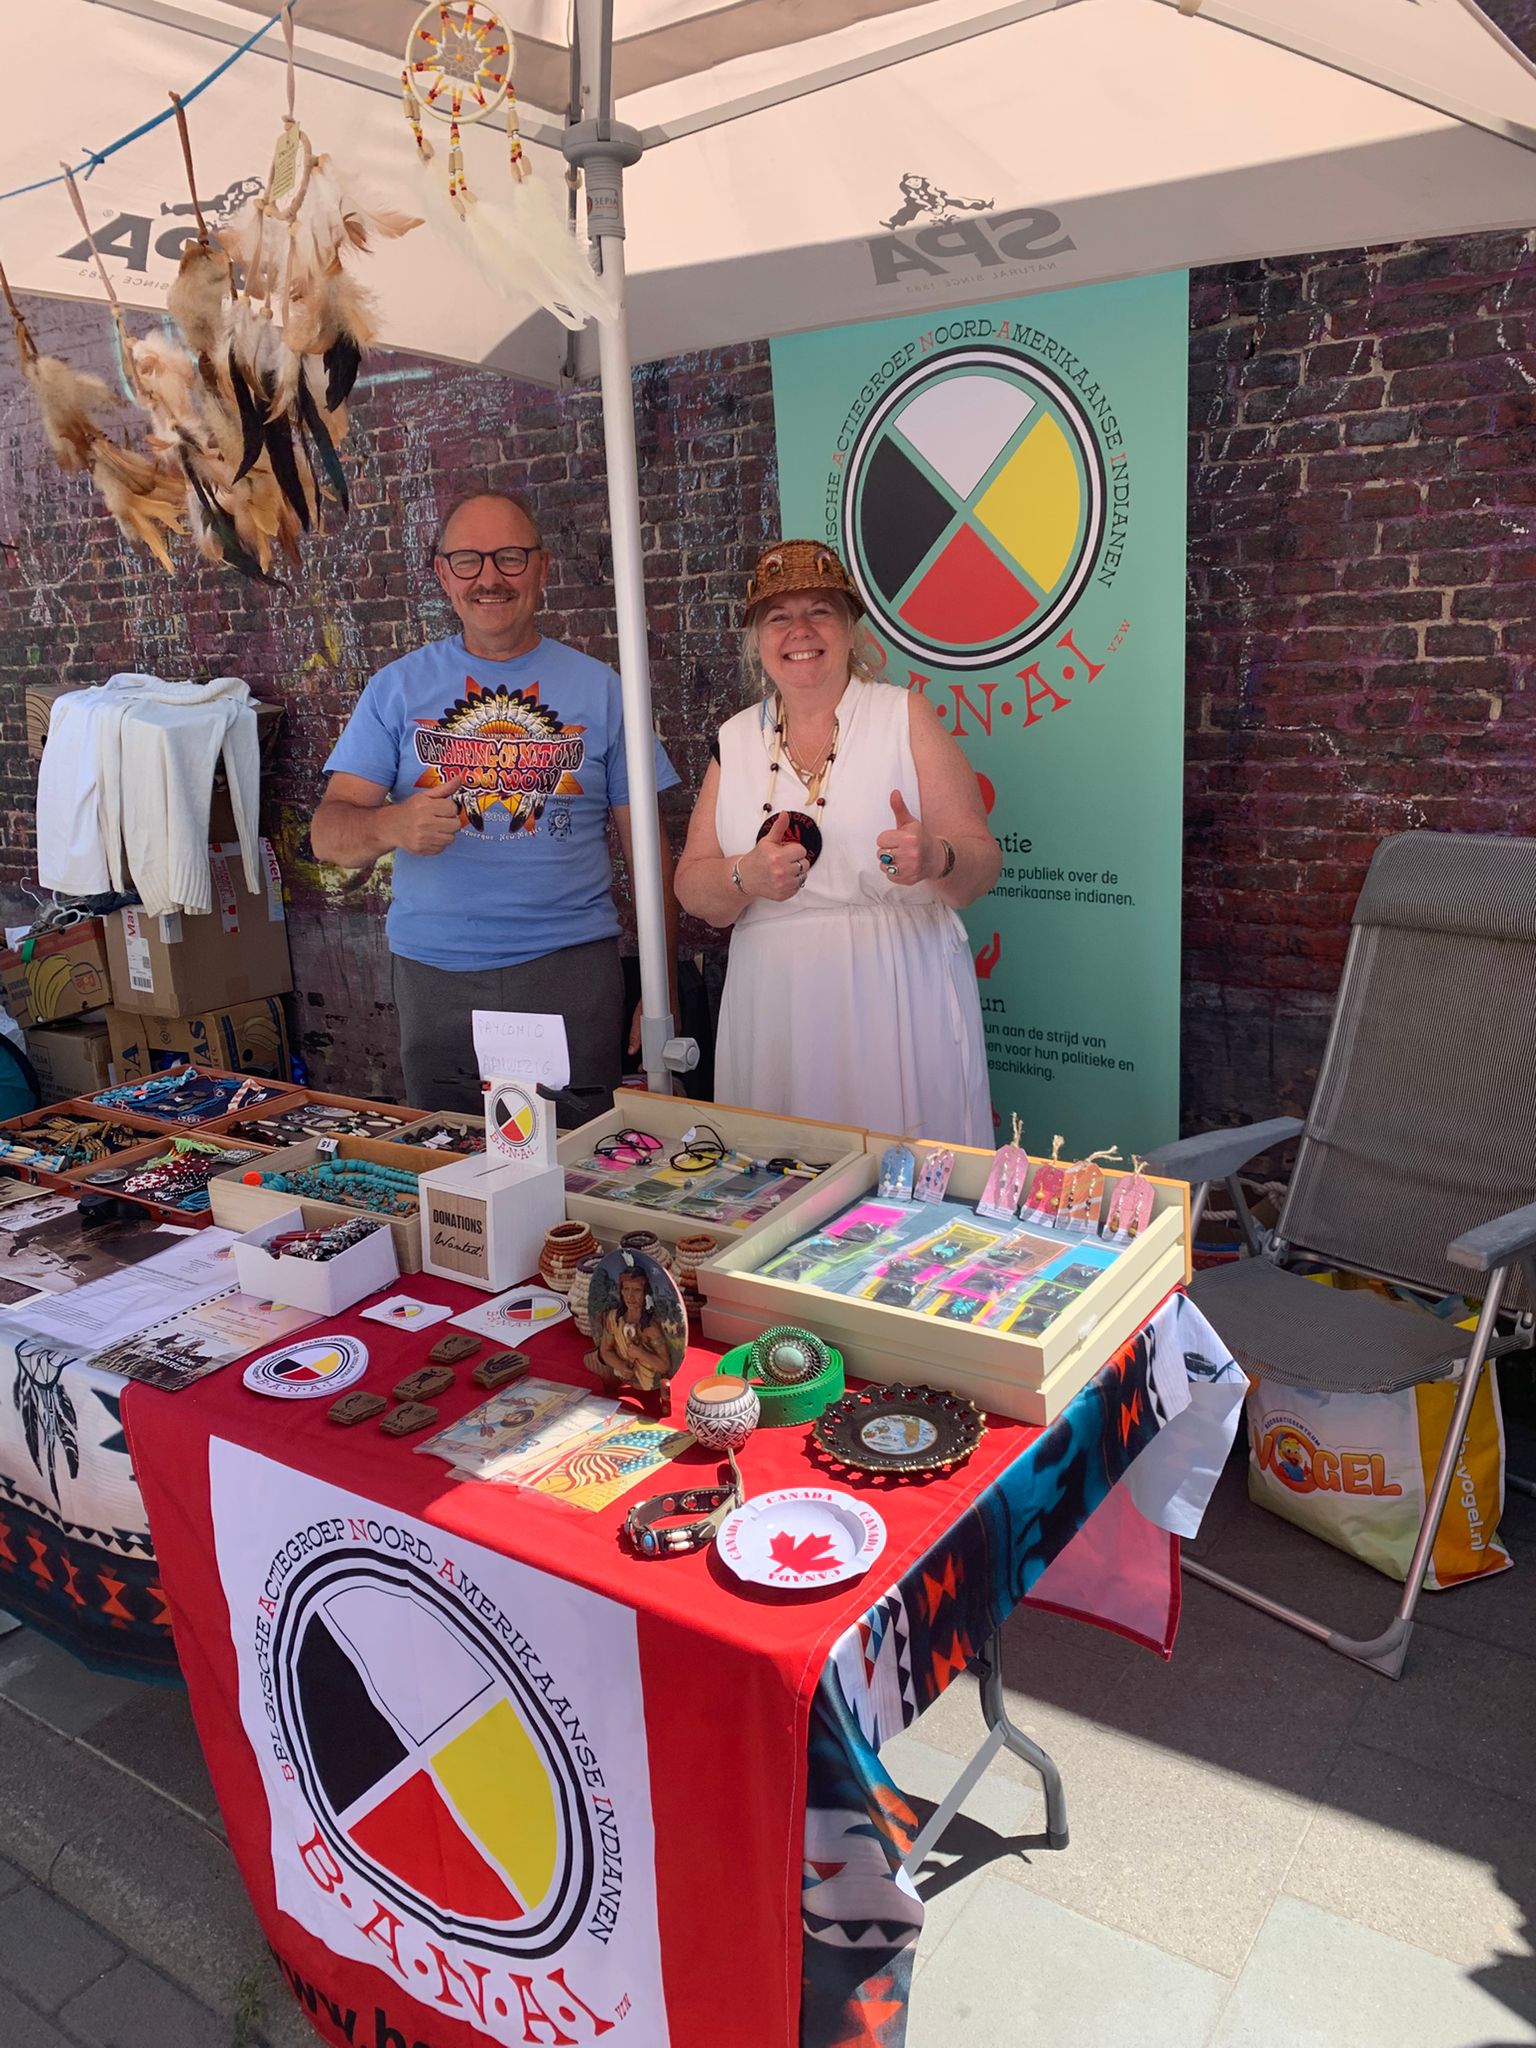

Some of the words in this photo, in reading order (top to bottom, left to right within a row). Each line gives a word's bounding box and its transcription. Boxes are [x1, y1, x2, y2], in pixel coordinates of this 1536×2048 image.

[831, 342, 918, 469] ACTIEGROEP
[824, 471, 842, 555] ISCHE
[1097, 451, 1131, 590] INDIANEN
[1018, 866, 1065, 882] publiek
[1068, 871, 1099, 883] over
[1101, 870, 1119, 885] de
[1074, 888, 1136, 907] indianen.
[1002, 1025, 1026, 1039] aan
[1028, 1026, 1044, 1041] de
[1046, 1030, 1079, 1047] strijd
[1082, 1035, 1107, 1049] van
[987, 1058, 1056, 1081] eschikking.
[1004, 1044, 1032, 1057] voor
[1034, 1046, 1059, 1061] hun
[1061, 1050, 1116, 1069] politieke
[1118, 1060, 1135, 1072] en
[433, 1208, 483, 1235] DONATIONS
[433, 1231, 485, 1257] Wanted!
[1252, 1424, 1403, 1497] VOGEL
[766, 1491, 834, 1505] CANADA
[724, 1519, 744, 1560] CANADA
[859, 1511, 880, 1553] CANADA
[258, 1517, 345, 1619] ACTIEGROEP
[767, 1567, 842, 1584] CANADA
[254, 1615, 296, 1783] BELGISCHE
[588, 1795, 624, 1946] INDIANEN
